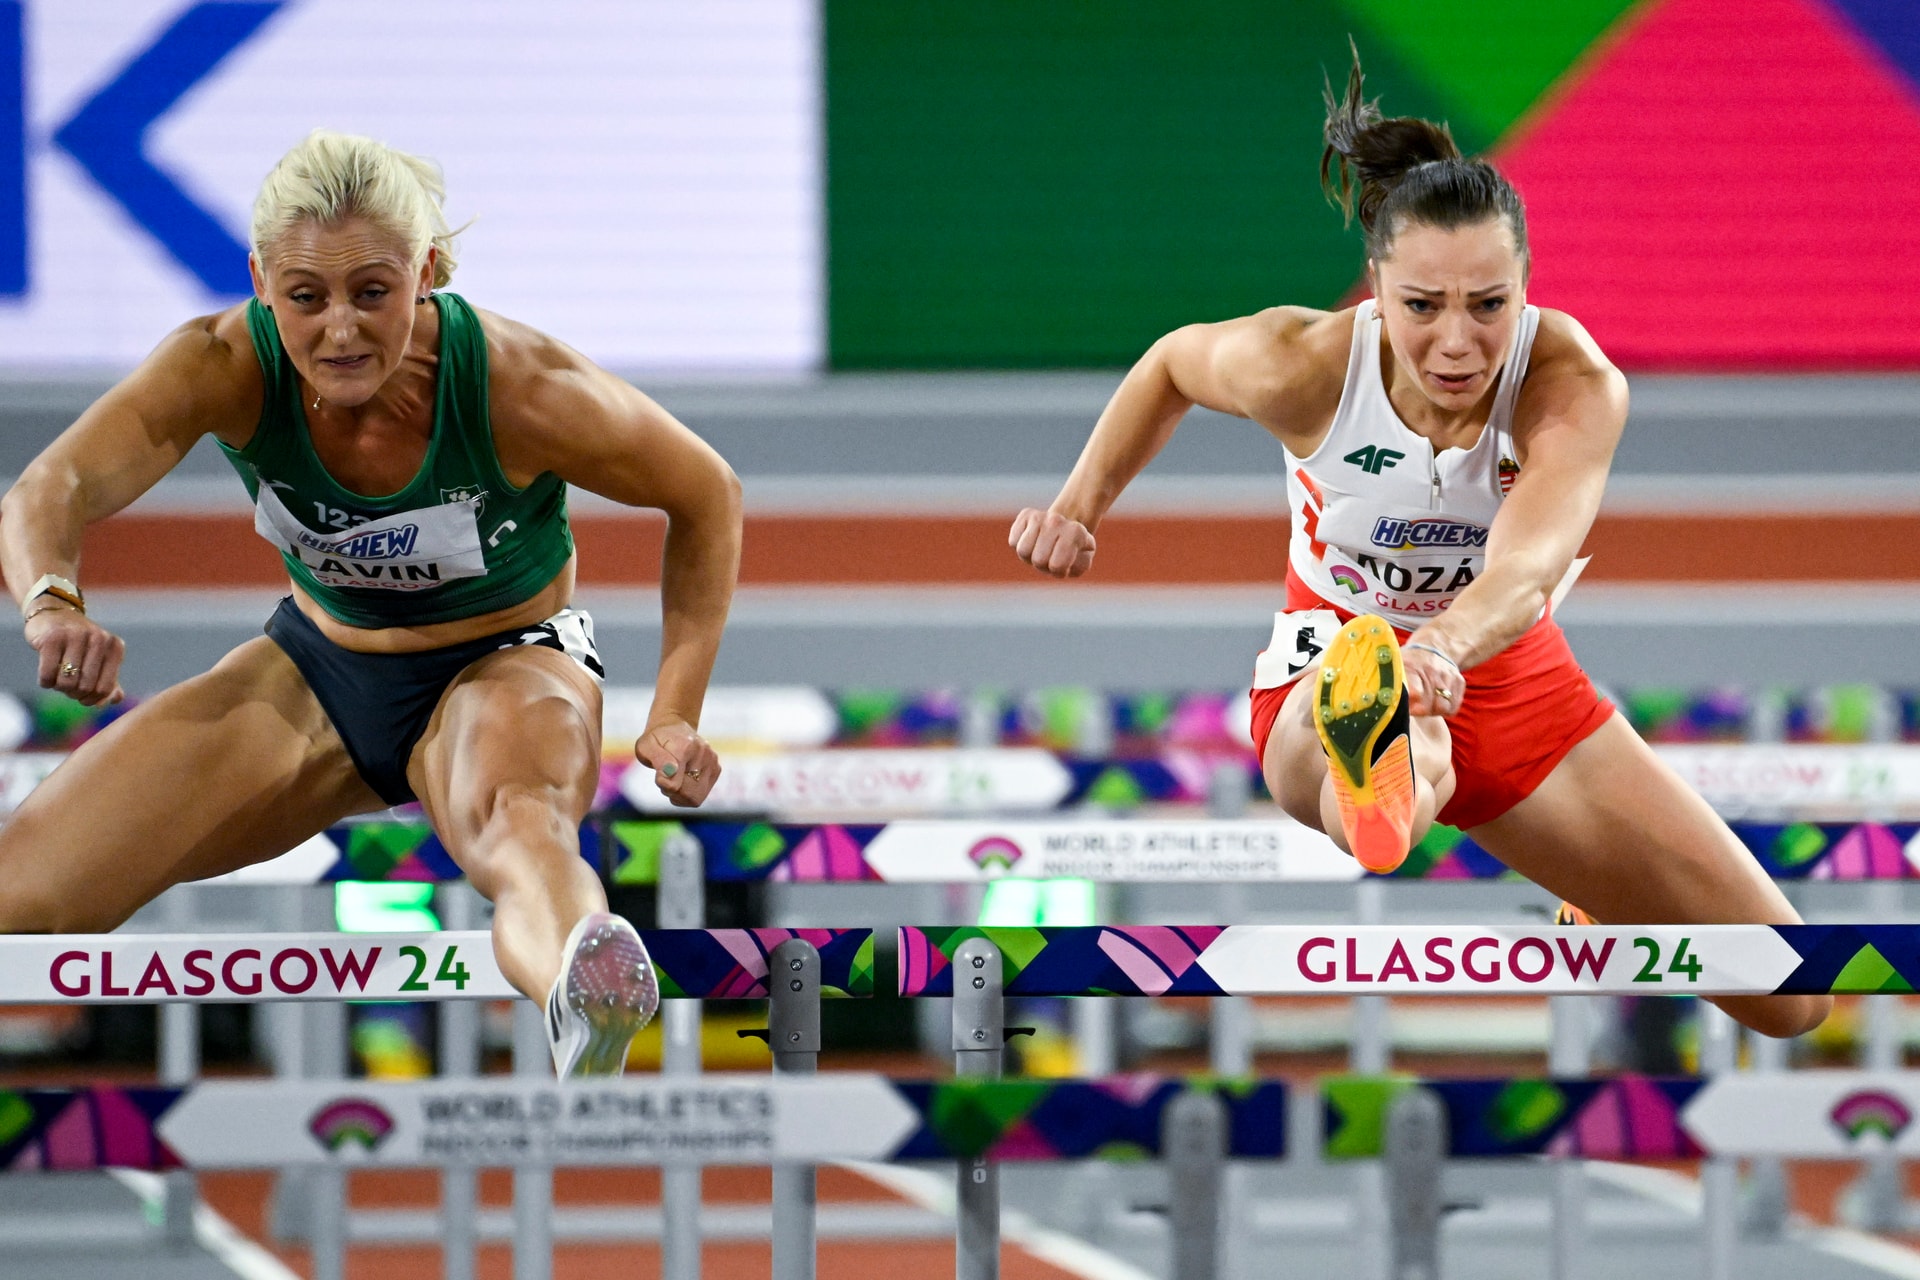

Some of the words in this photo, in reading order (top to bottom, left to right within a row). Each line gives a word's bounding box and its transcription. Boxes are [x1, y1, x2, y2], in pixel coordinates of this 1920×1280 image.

[1343, 444, 1406, 475] 4F
[1371, 516, 1490, 549] HI-CHEW
[289, 543, 440, 581] LAVIN
[49, 946, 382, 997] GLASGOW
[398, 945, 470, 991] 24
[1297, 936, 1617, 984] GLASGOW
[1632, 937, 1703, 983] 24
